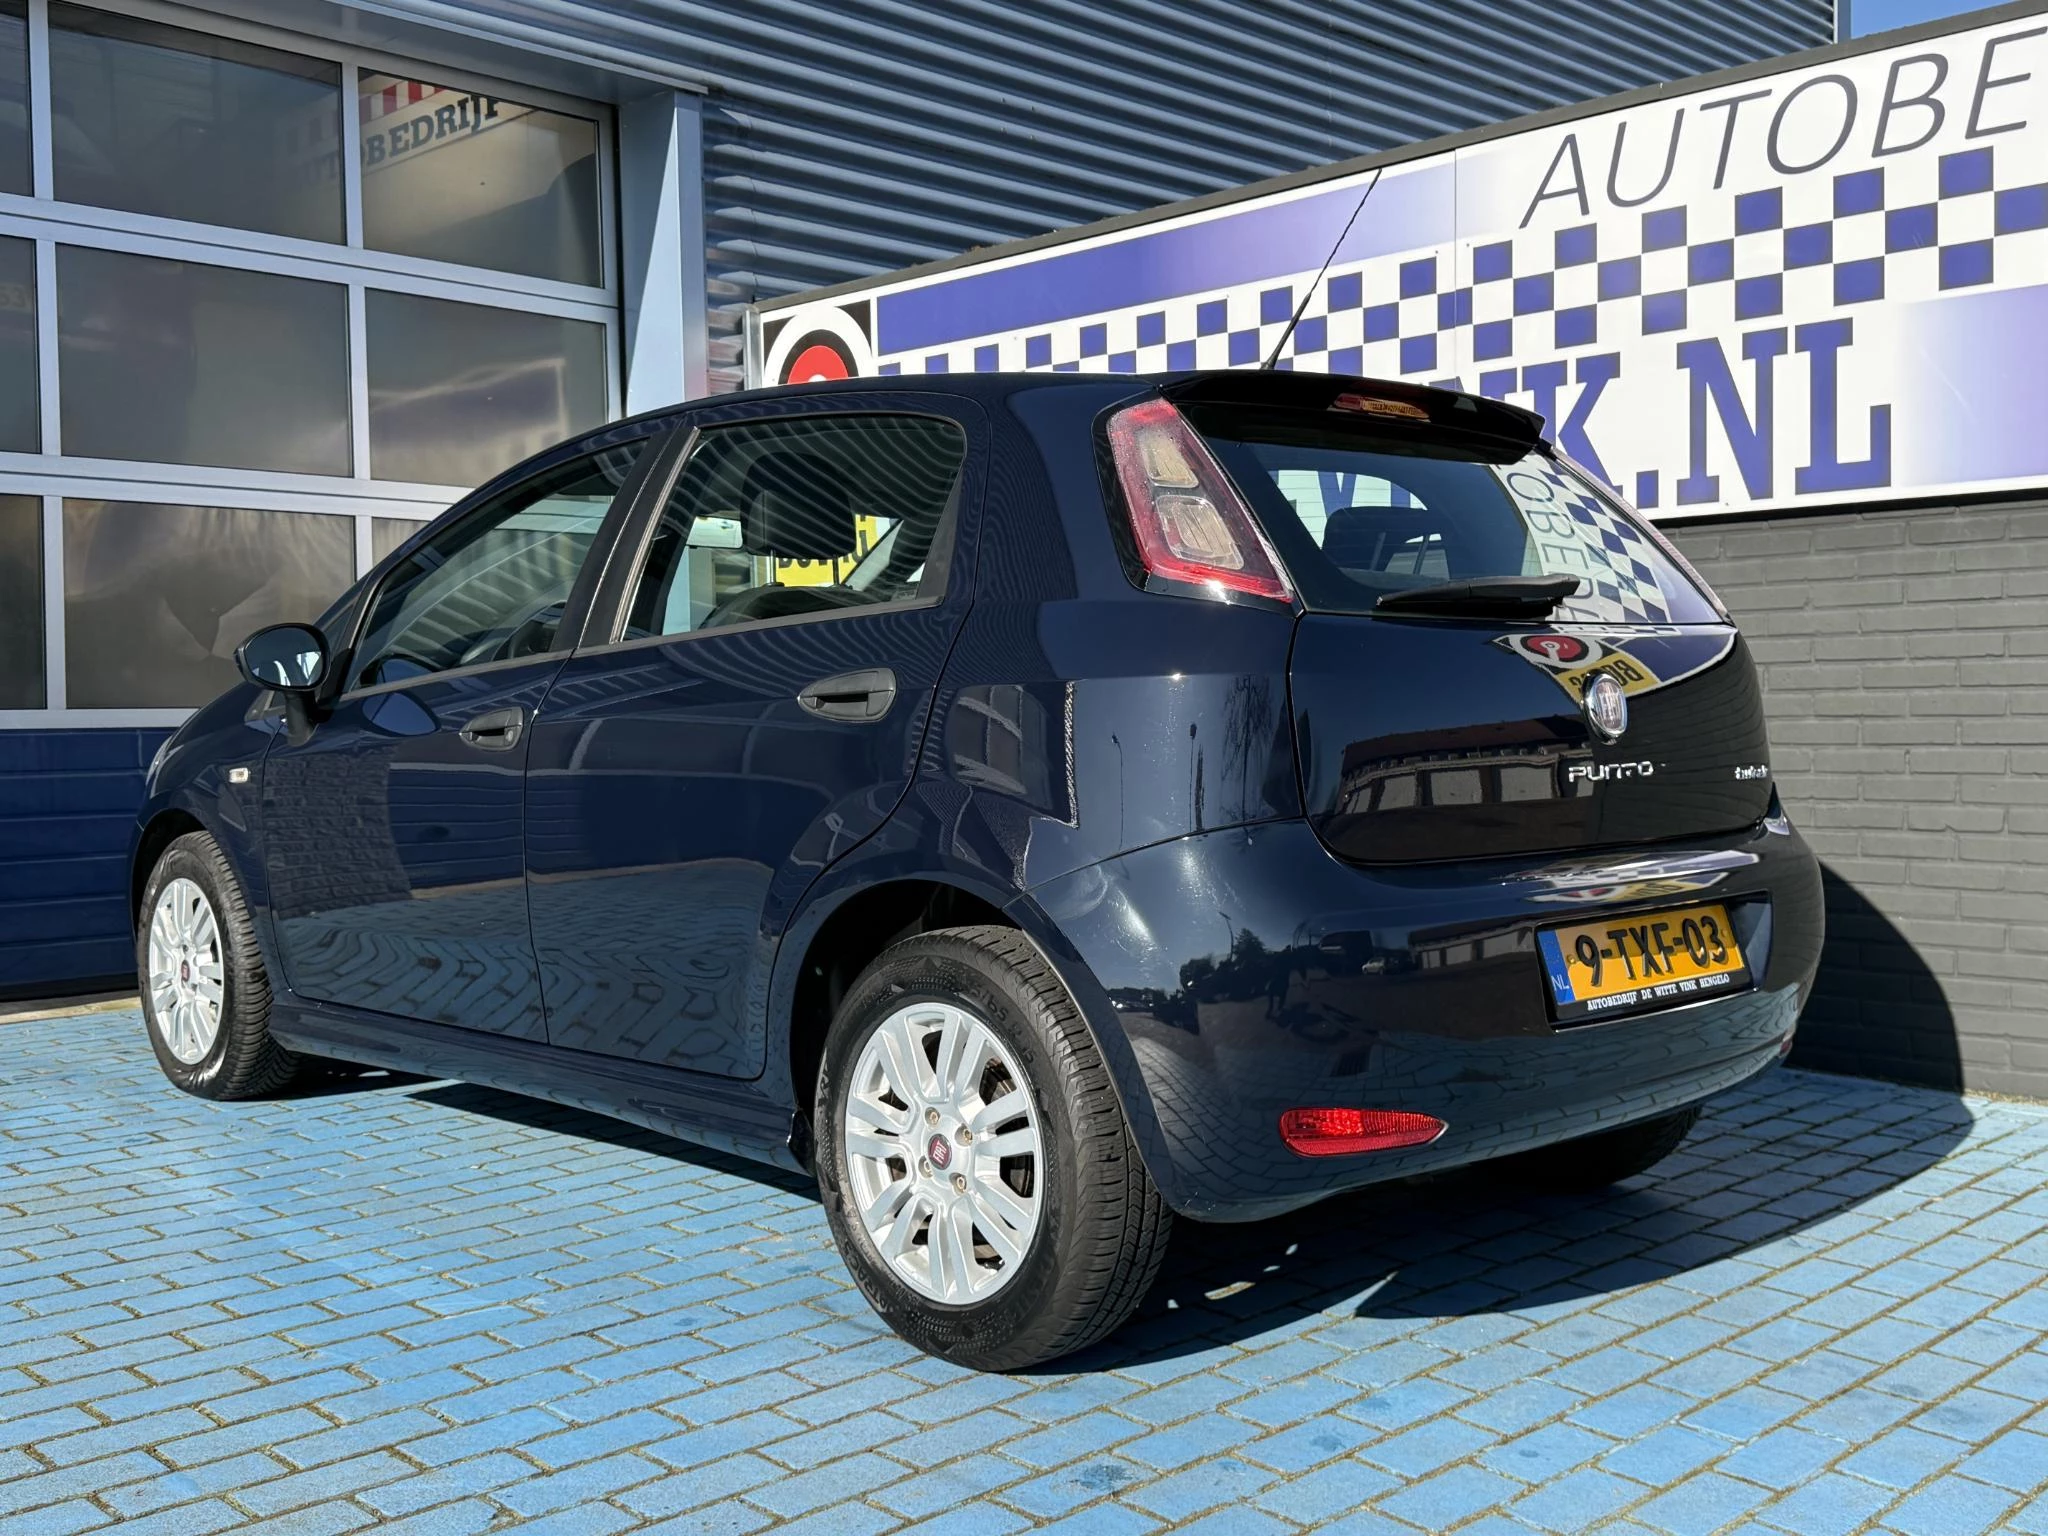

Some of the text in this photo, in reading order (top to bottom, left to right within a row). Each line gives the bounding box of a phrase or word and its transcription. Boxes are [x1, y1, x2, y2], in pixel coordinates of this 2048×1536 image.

[1568, 761, 1654, 783] PUNTO
[1575, 915, 1729, 987] 9-TXF-03
[1551, 975, 1570, 991] NL
[1587, 973, 1730, 1011] AUTOBEDRIJF DE WITTE VINK HENGELO
[932, 1139, 947, 1164] FIAT
